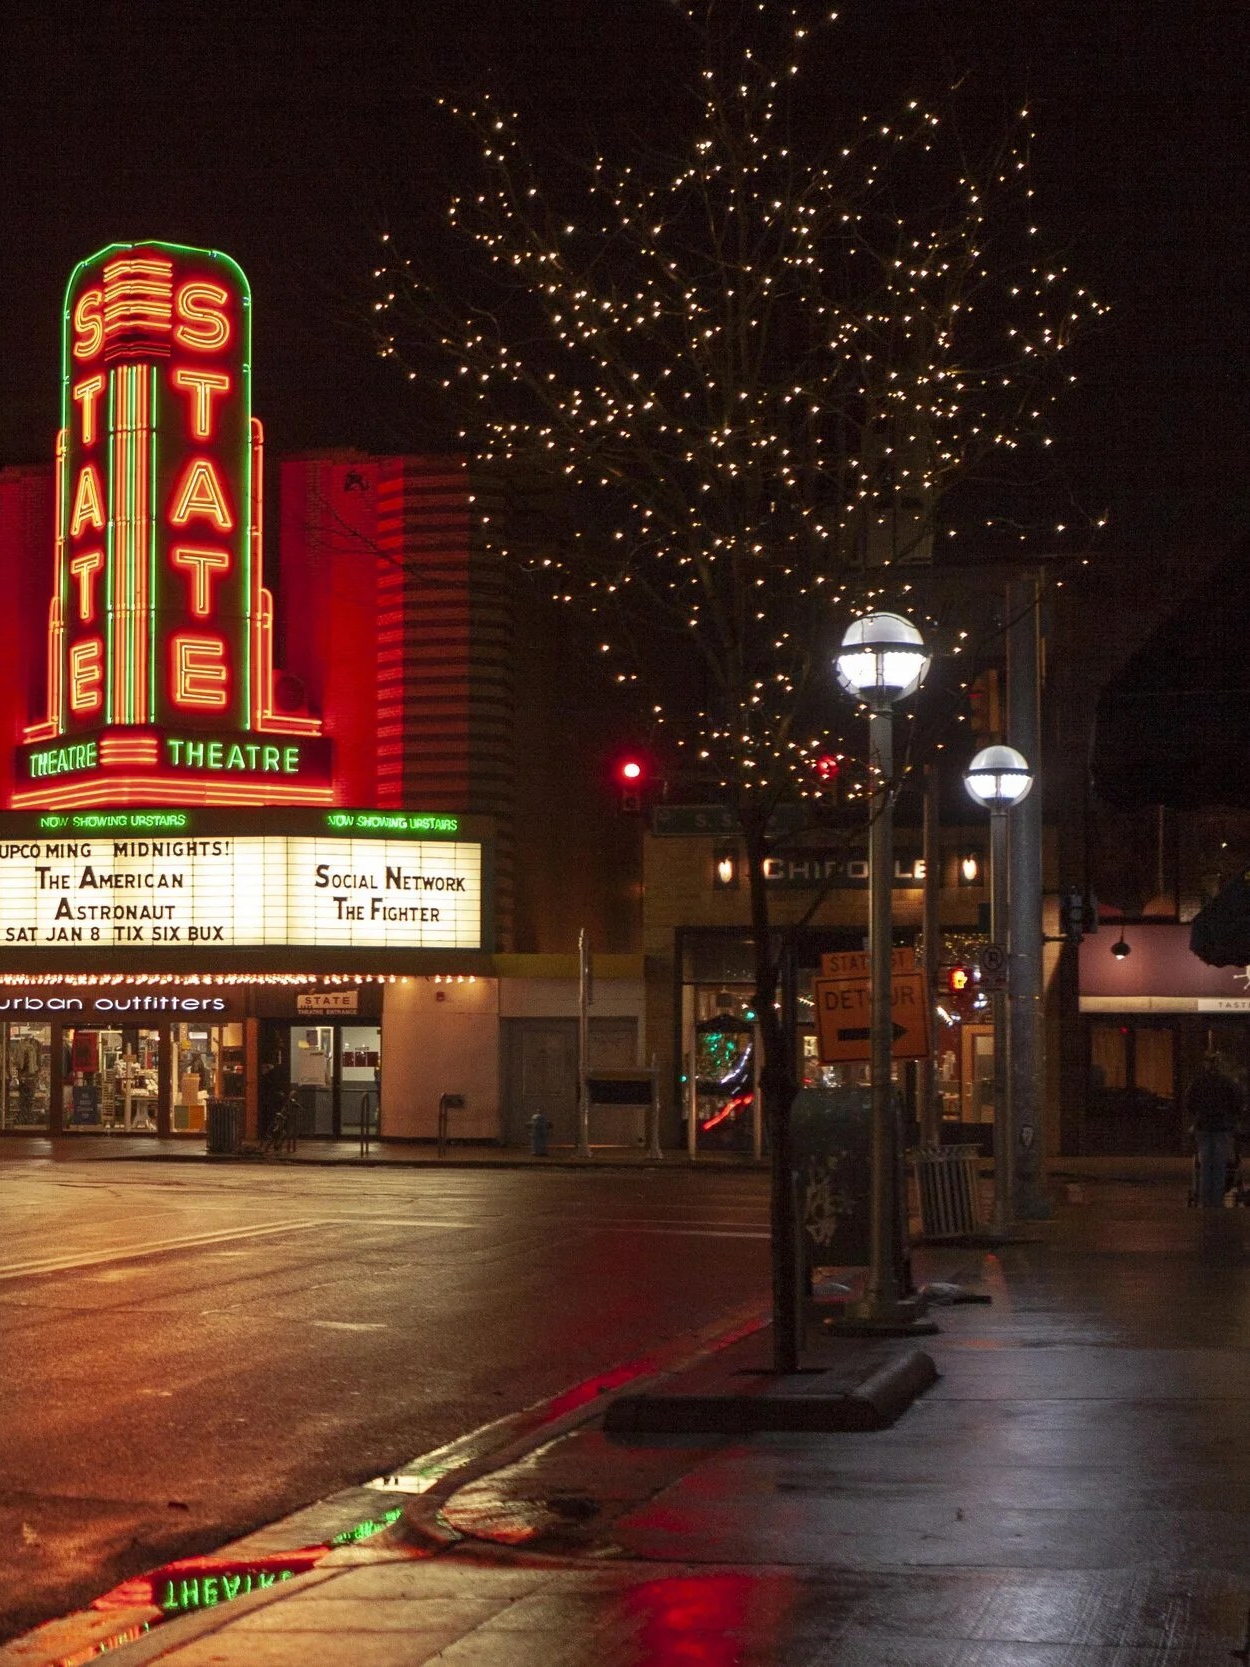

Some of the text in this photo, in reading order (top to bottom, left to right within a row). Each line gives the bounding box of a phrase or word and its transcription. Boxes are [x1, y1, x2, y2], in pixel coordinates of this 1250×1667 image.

[69, 289, 104, 711] STATE
[172, 282, 232, 705] STATE
[29, 742, 98, 778] THEATRE
[167, 739, 299, 773] THEATRE
[40, 814, 186, 828] NOW SHOWING UPSTAIRS
[328, 815, 458, 831] NOW SHOWING UPSTAIRS
[113, 841, 230, 857] MIDNIGHTS!
[761, 856, 928, 880] CHIPOLE
[5, 925, 225, 942] SAT JAN 8 TIX SIX BUX
[829, 954, 872, 972] STAT
[94, 995, 226, 1011] outfitters
[305, 996, 351, 1005] STATE
[824, 985, 916, 1011] DETUR
